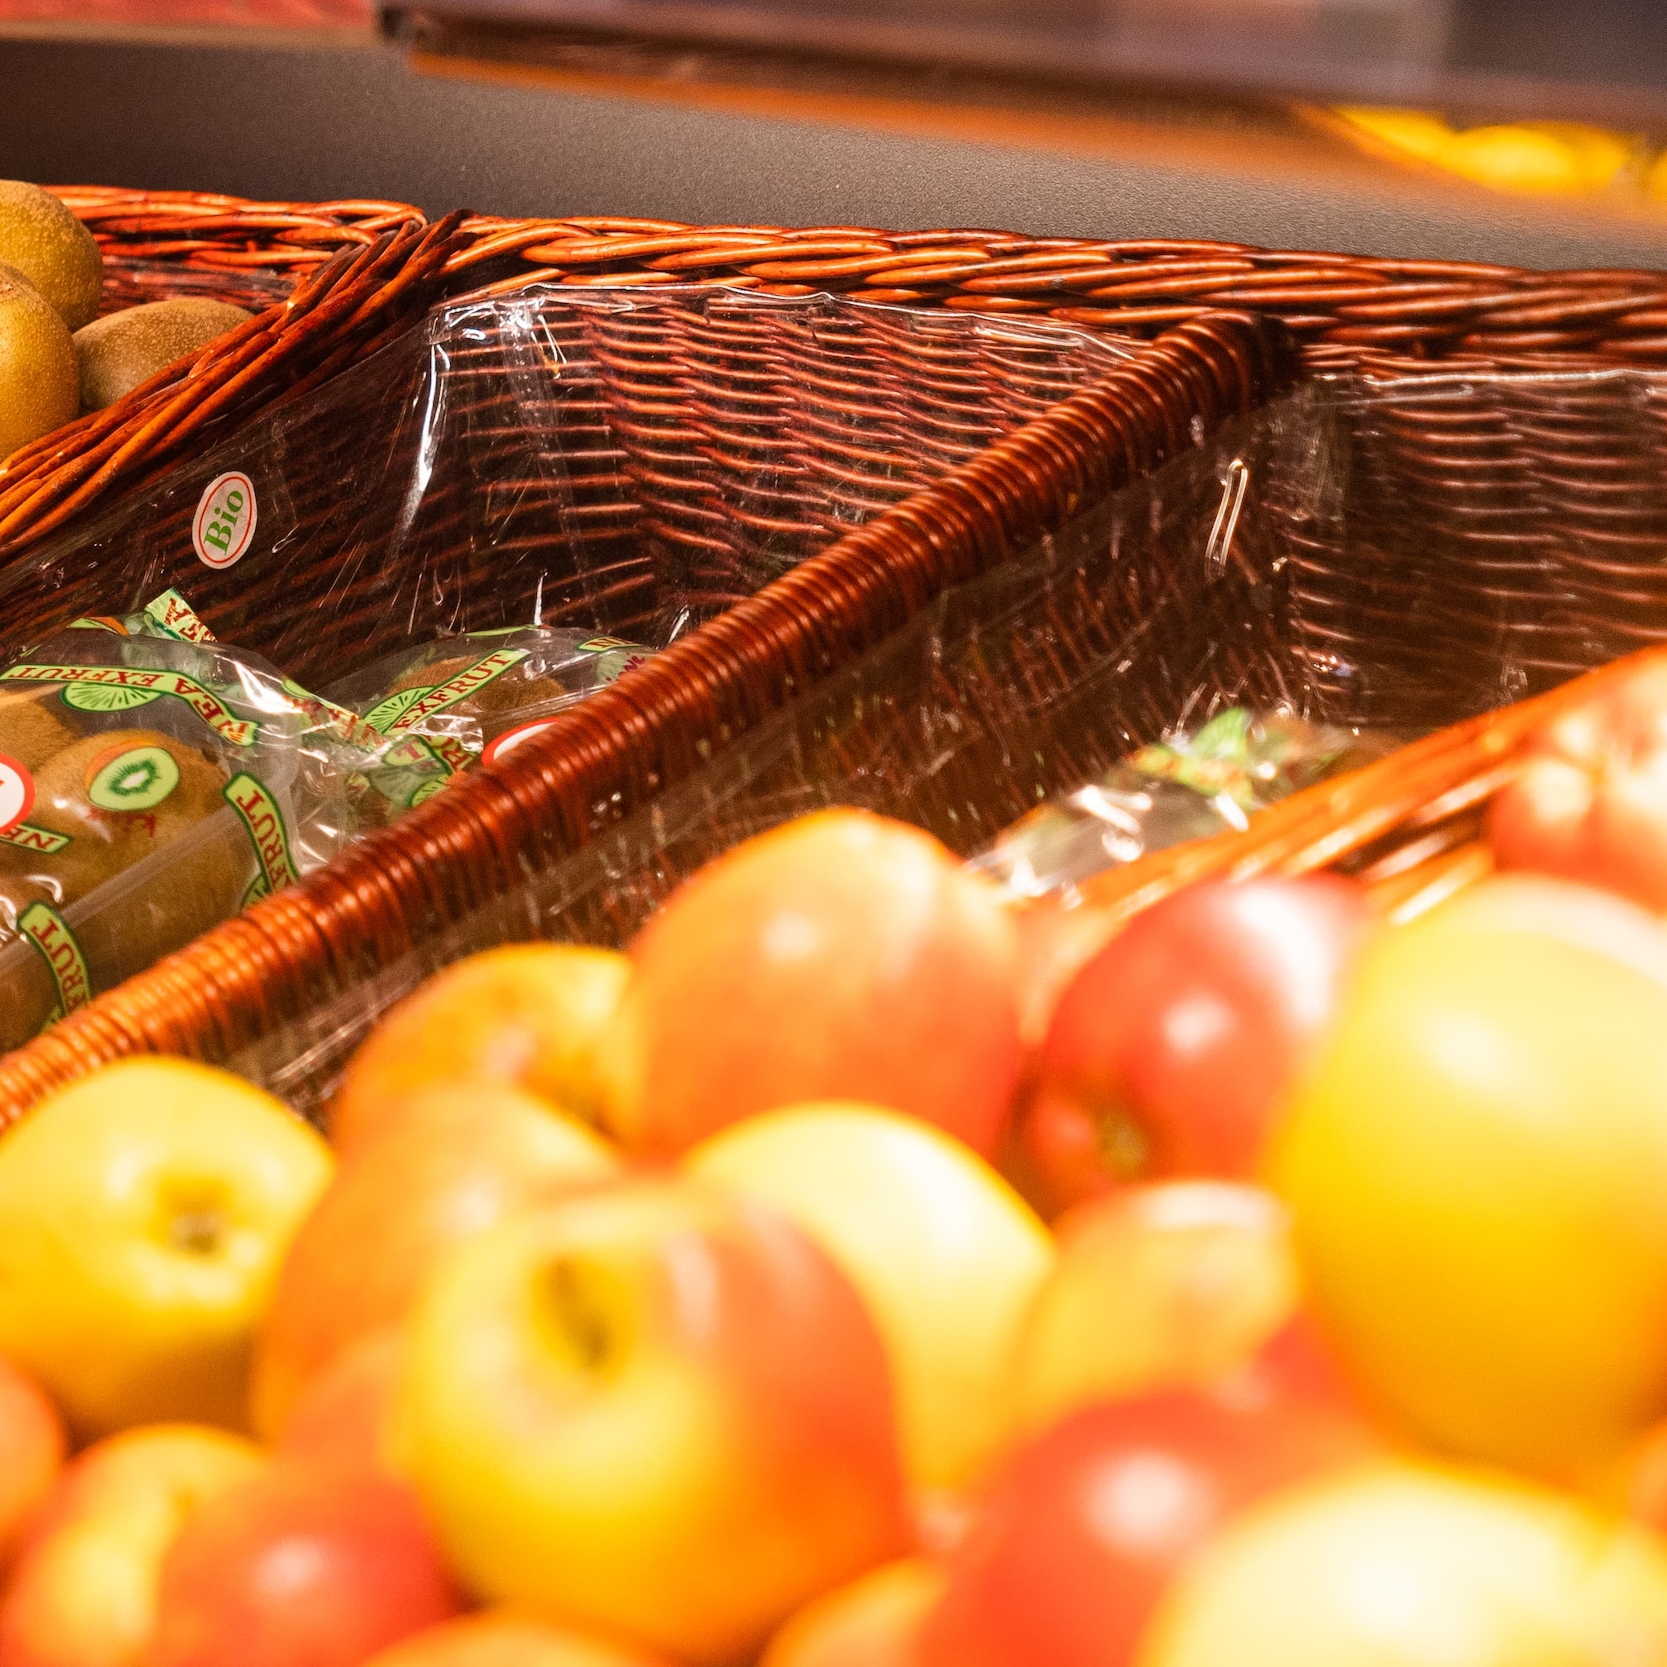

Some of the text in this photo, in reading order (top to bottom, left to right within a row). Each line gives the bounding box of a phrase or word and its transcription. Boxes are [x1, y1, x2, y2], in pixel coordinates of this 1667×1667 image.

[204, 490, 243, 555] Bio
[8, 667, 164, 688] EXFRUT
[174, 677, 249, 743] NEA
[390, 654, 511, 731] EXFRUT
[237, 790, 294, 890] FRUT
[31, 919, 87, 1010] FRUT
